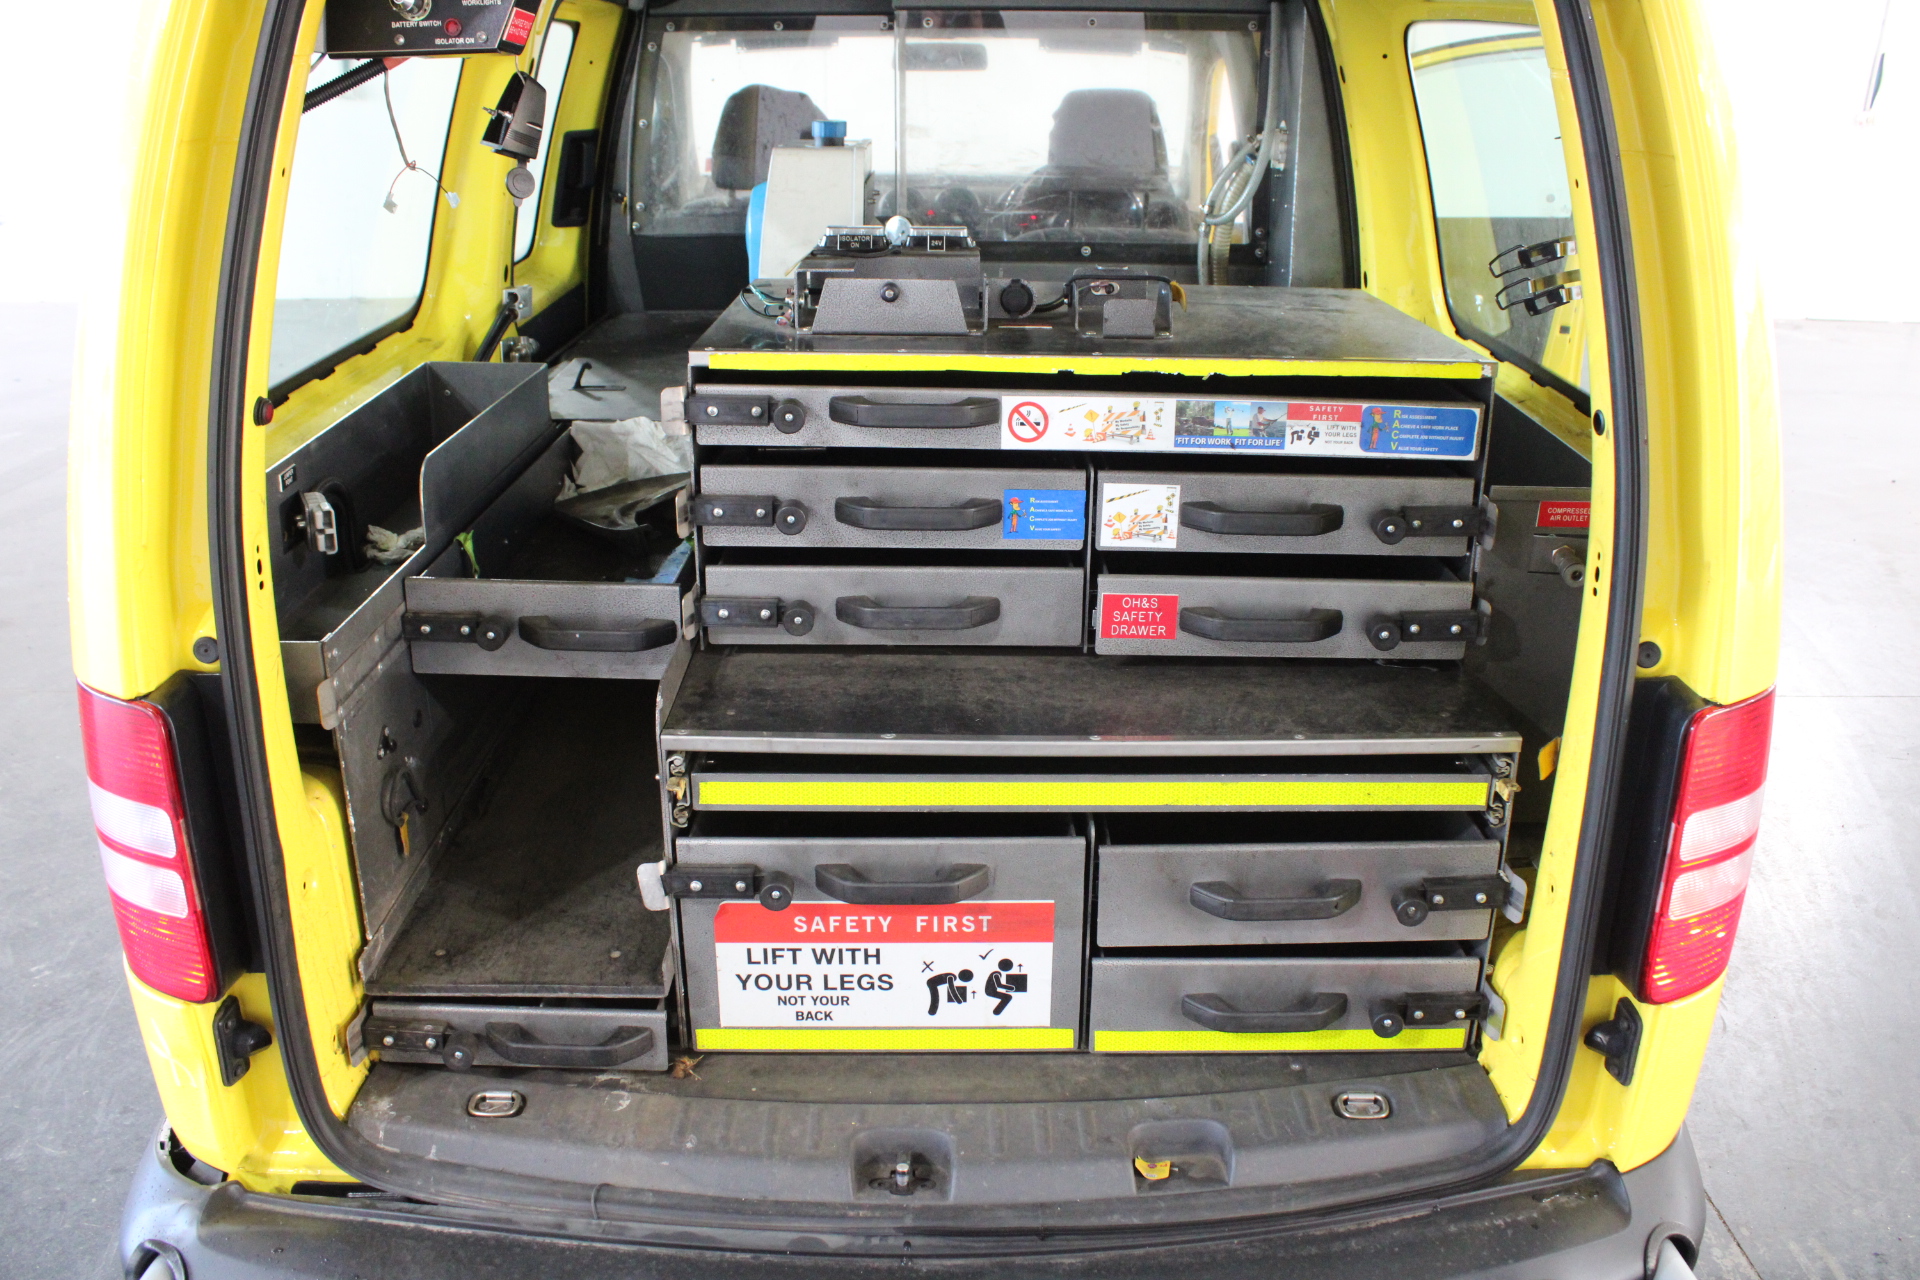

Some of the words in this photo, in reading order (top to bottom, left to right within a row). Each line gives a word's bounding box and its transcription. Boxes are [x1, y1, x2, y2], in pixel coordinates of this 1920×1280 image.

[1122, 597, 1158, 608] OH&S
[1113, 610, 1163, 622] SAFETY
[1111, 624, 1166, 636] DRAWER
[793, 916, 892, 933] SAFETY
[916, 916, 993, 932] FIRST
[746, 948, 802, 965] LIFT
[811, 948, 881, 965] WITH
[735, 974, 812, 991] YOUR
[824, 973, 894, 991] LEGS
[777, 995, 807, 1006] NOT
[810, 995, 850, 1006] YOUR
[795, 1010, 834, 1022] BACK
